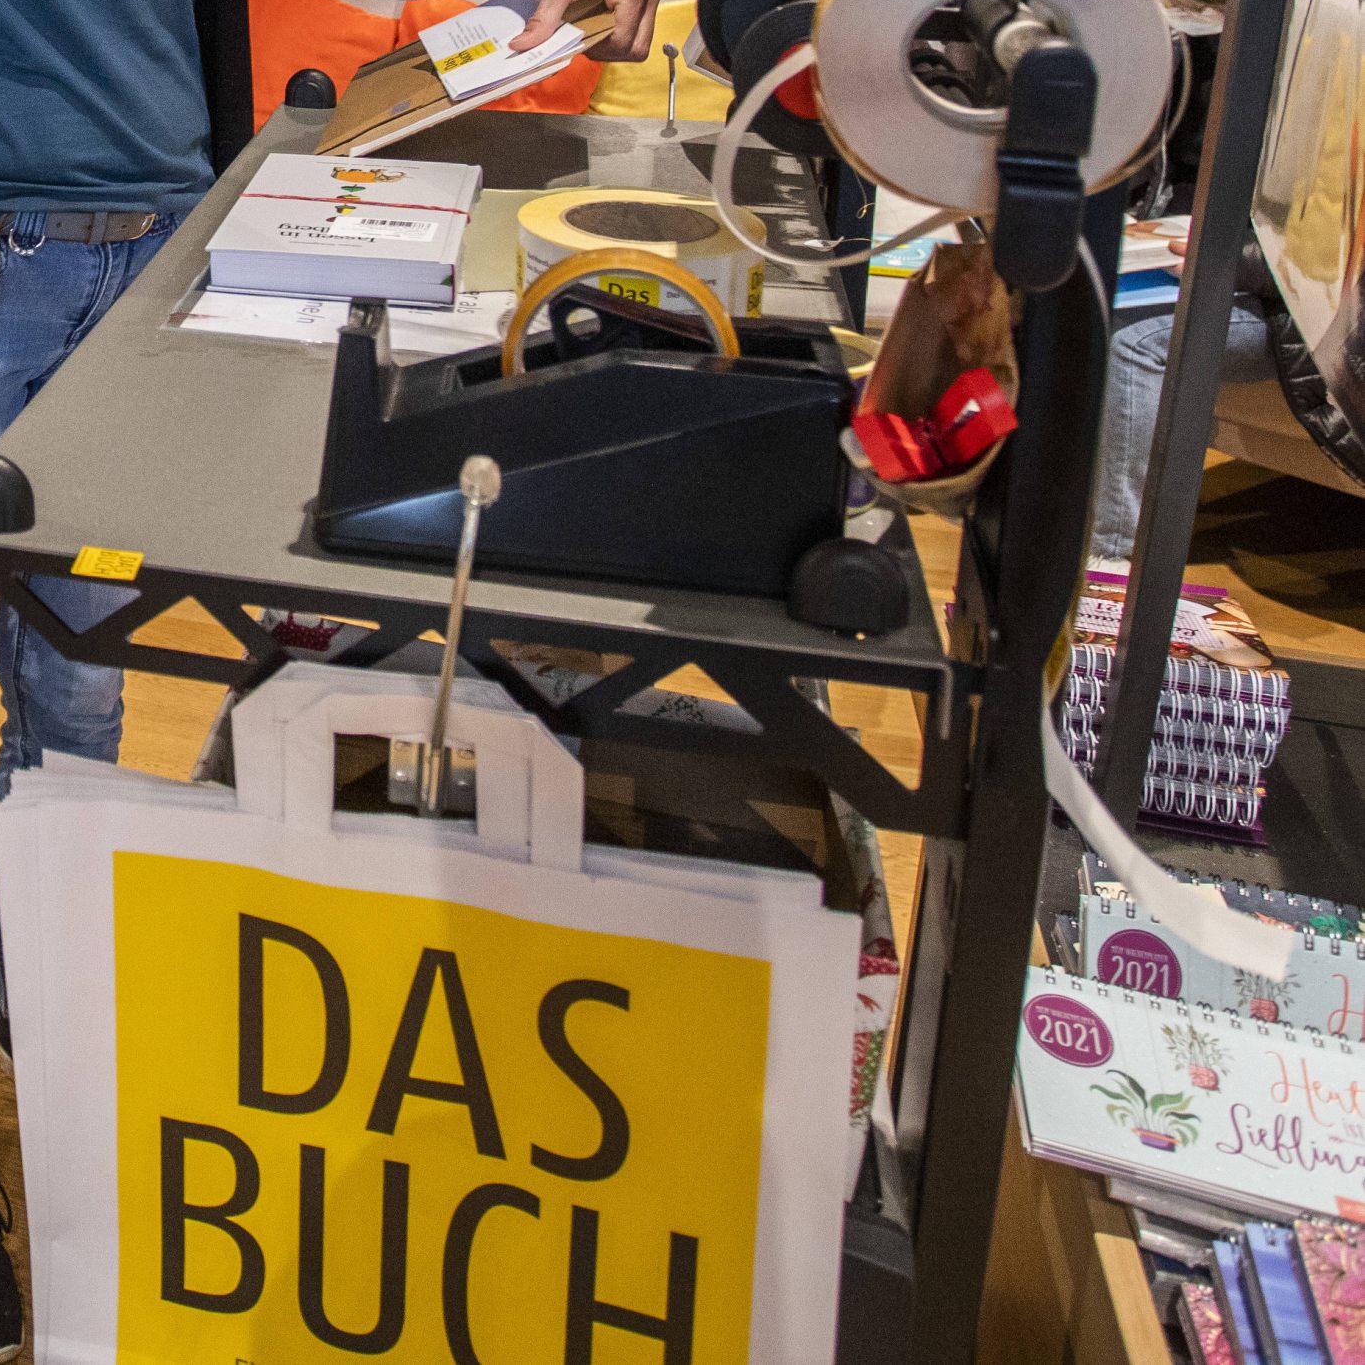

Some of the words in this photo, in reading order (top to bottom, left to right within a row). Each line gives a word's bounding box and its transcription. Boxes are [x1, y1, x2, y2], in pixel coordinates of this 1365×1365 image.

[277, 222, 332, 234] lberg
[279, 230, 300, 239] in
[607, 282, 651, 305] Das
[1109, 955, 1171, 998] 2021
[238, 911, 632, 1184] DAS
[1037, 1014, 1104, 1056] 2021
[1265, 1050, 1365, 1128] Heut
[1214, 1103, 1365, 1175] Lieblin
[158, 1115, 701, 1365] BUCH
